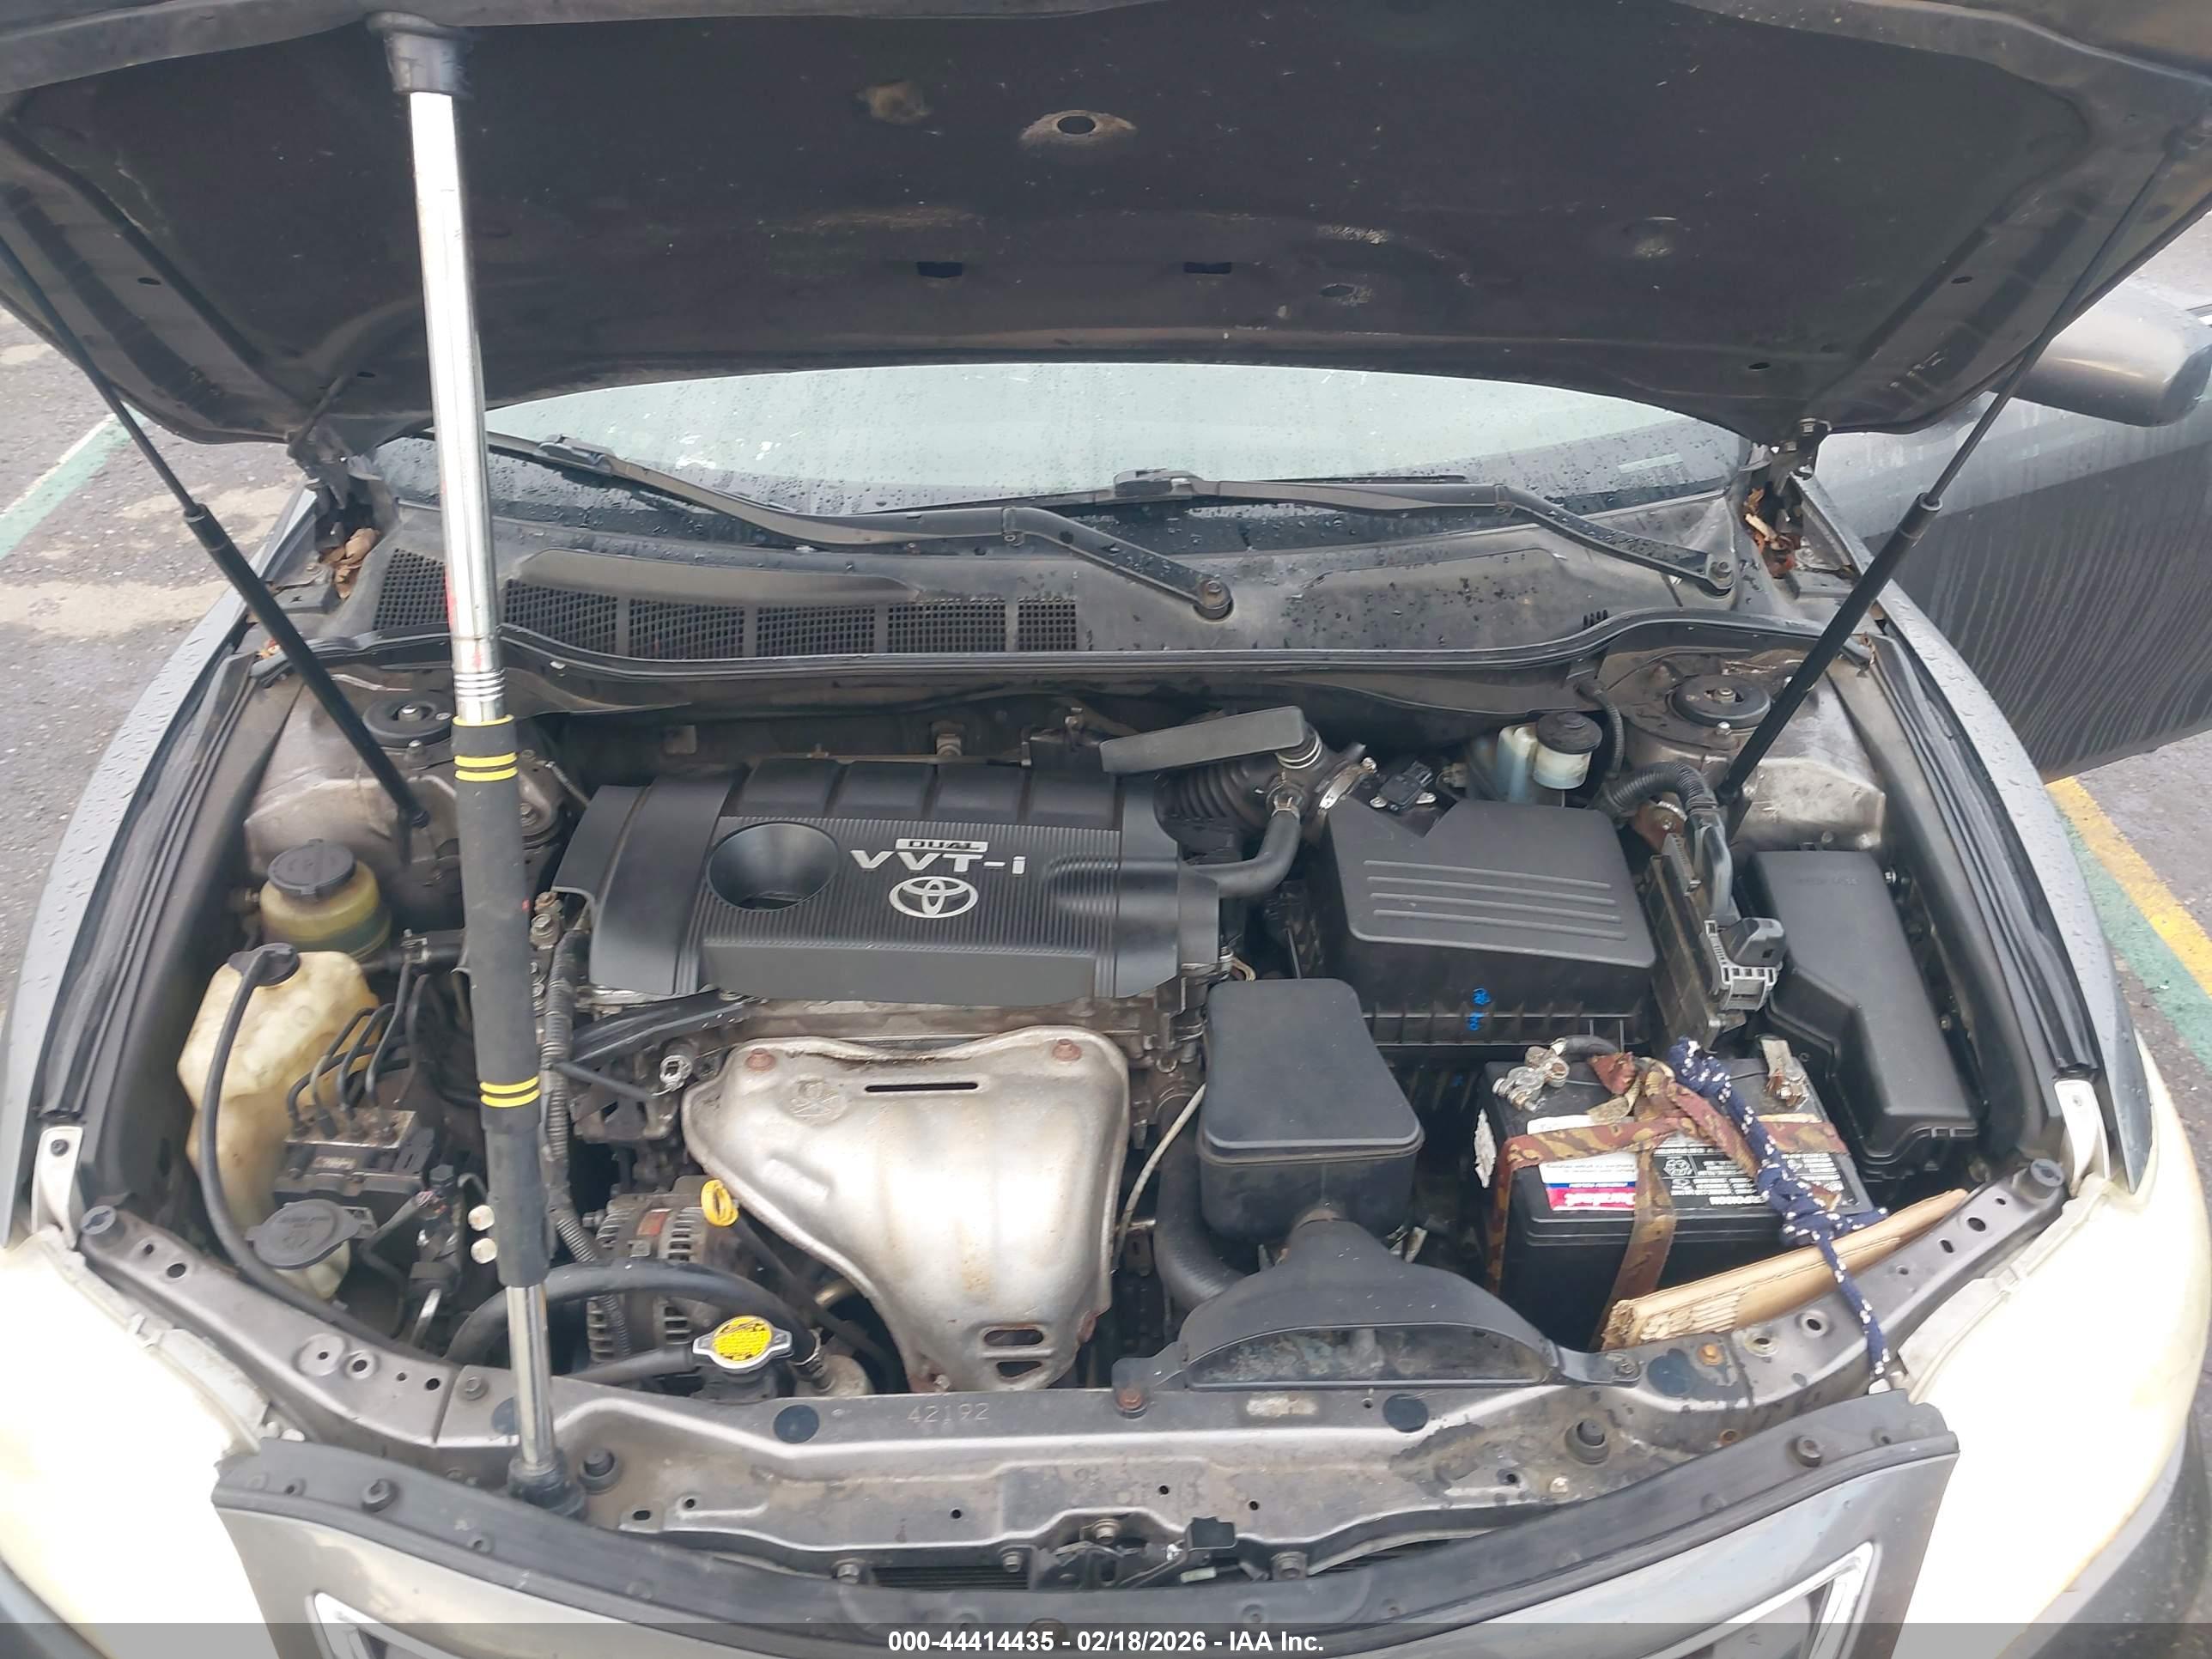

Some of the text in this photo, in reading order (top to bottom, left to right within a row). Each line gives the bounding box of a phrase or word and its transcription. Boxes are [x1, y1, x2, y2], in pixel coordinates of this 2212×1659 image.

[907, 839, 981, 851] DUAL
[850, 849, 1026, 875] VVT-i
[907, 1402, 990, 1424] 42192
